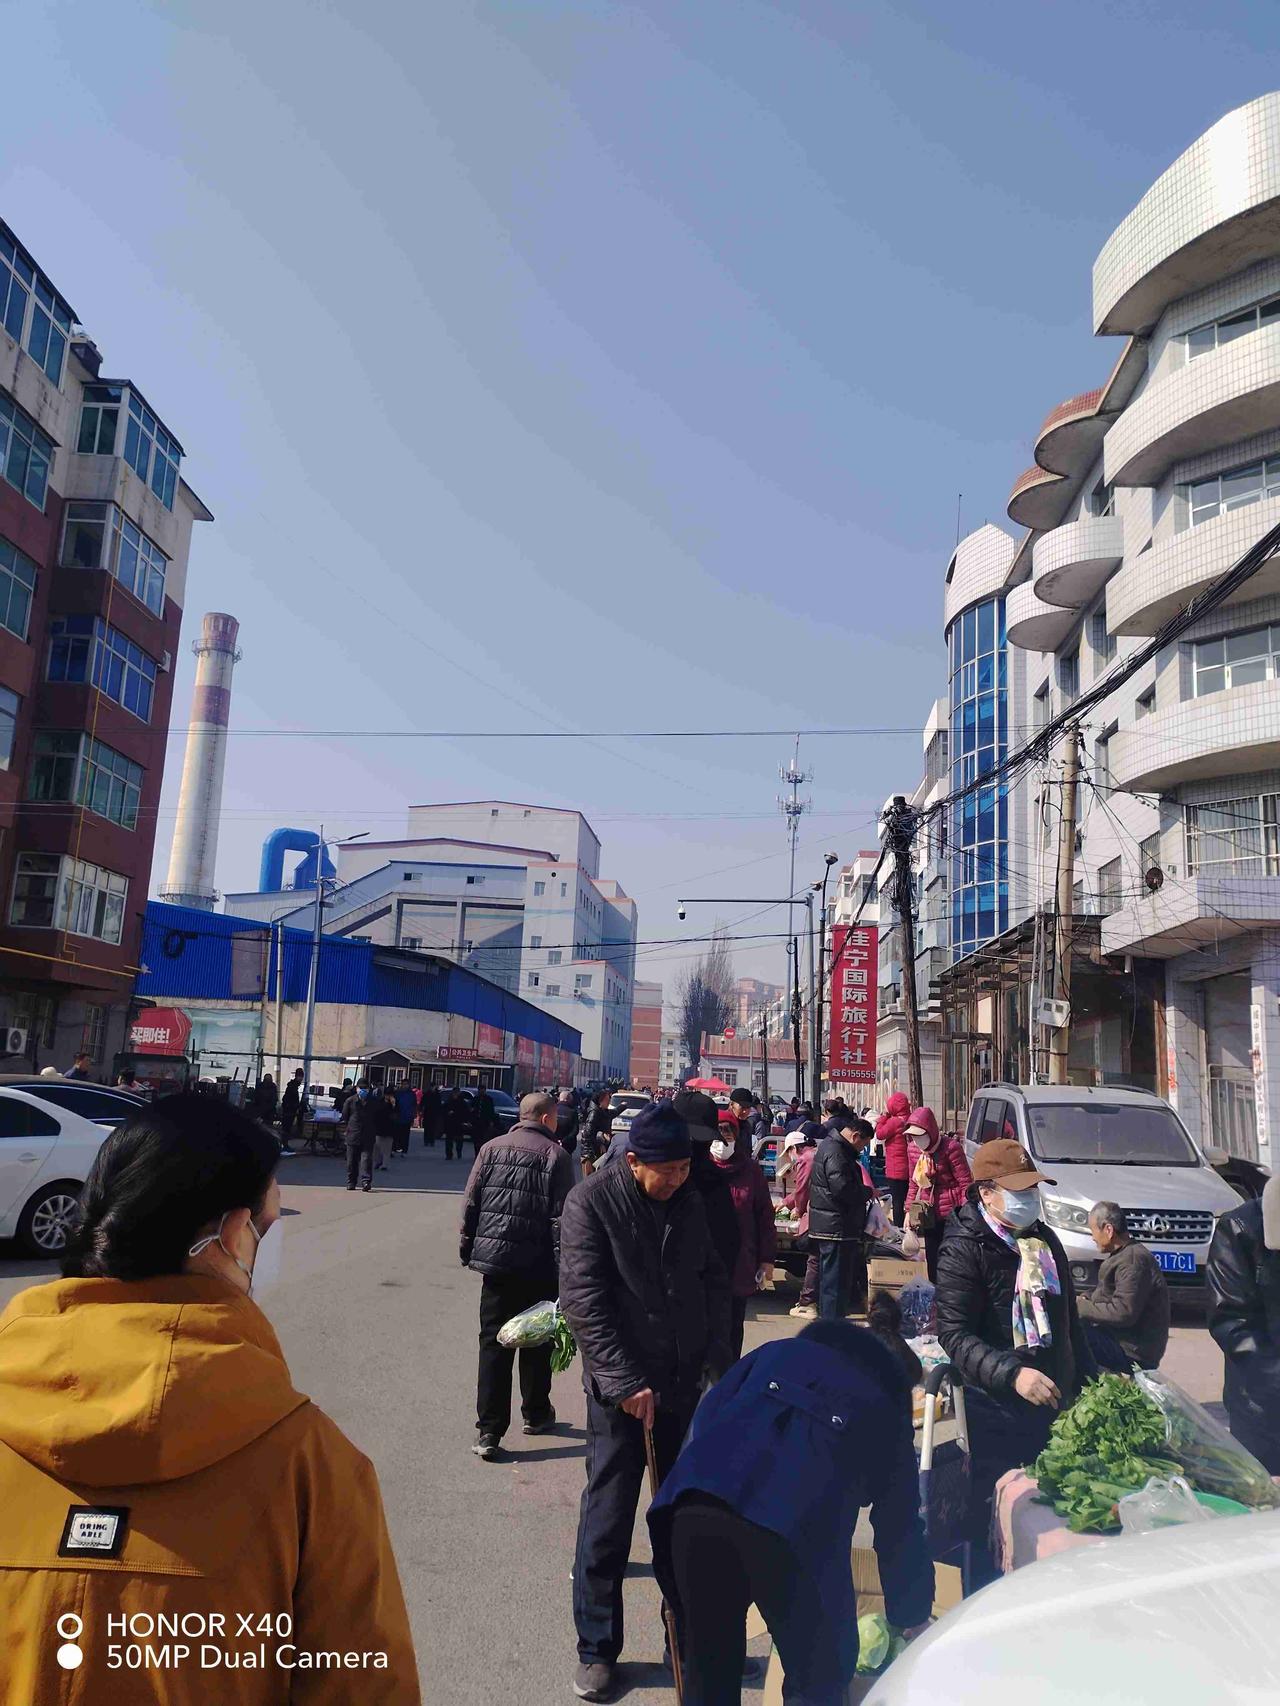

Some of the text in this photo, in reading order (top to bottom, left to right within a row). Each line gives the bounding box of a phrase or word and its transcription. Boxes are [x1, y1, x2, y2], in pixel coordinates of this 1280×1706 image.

[841, 930, 870, 1066] 佳宁国际旅行社
[841, 1068, 877, 1080] 6155555
